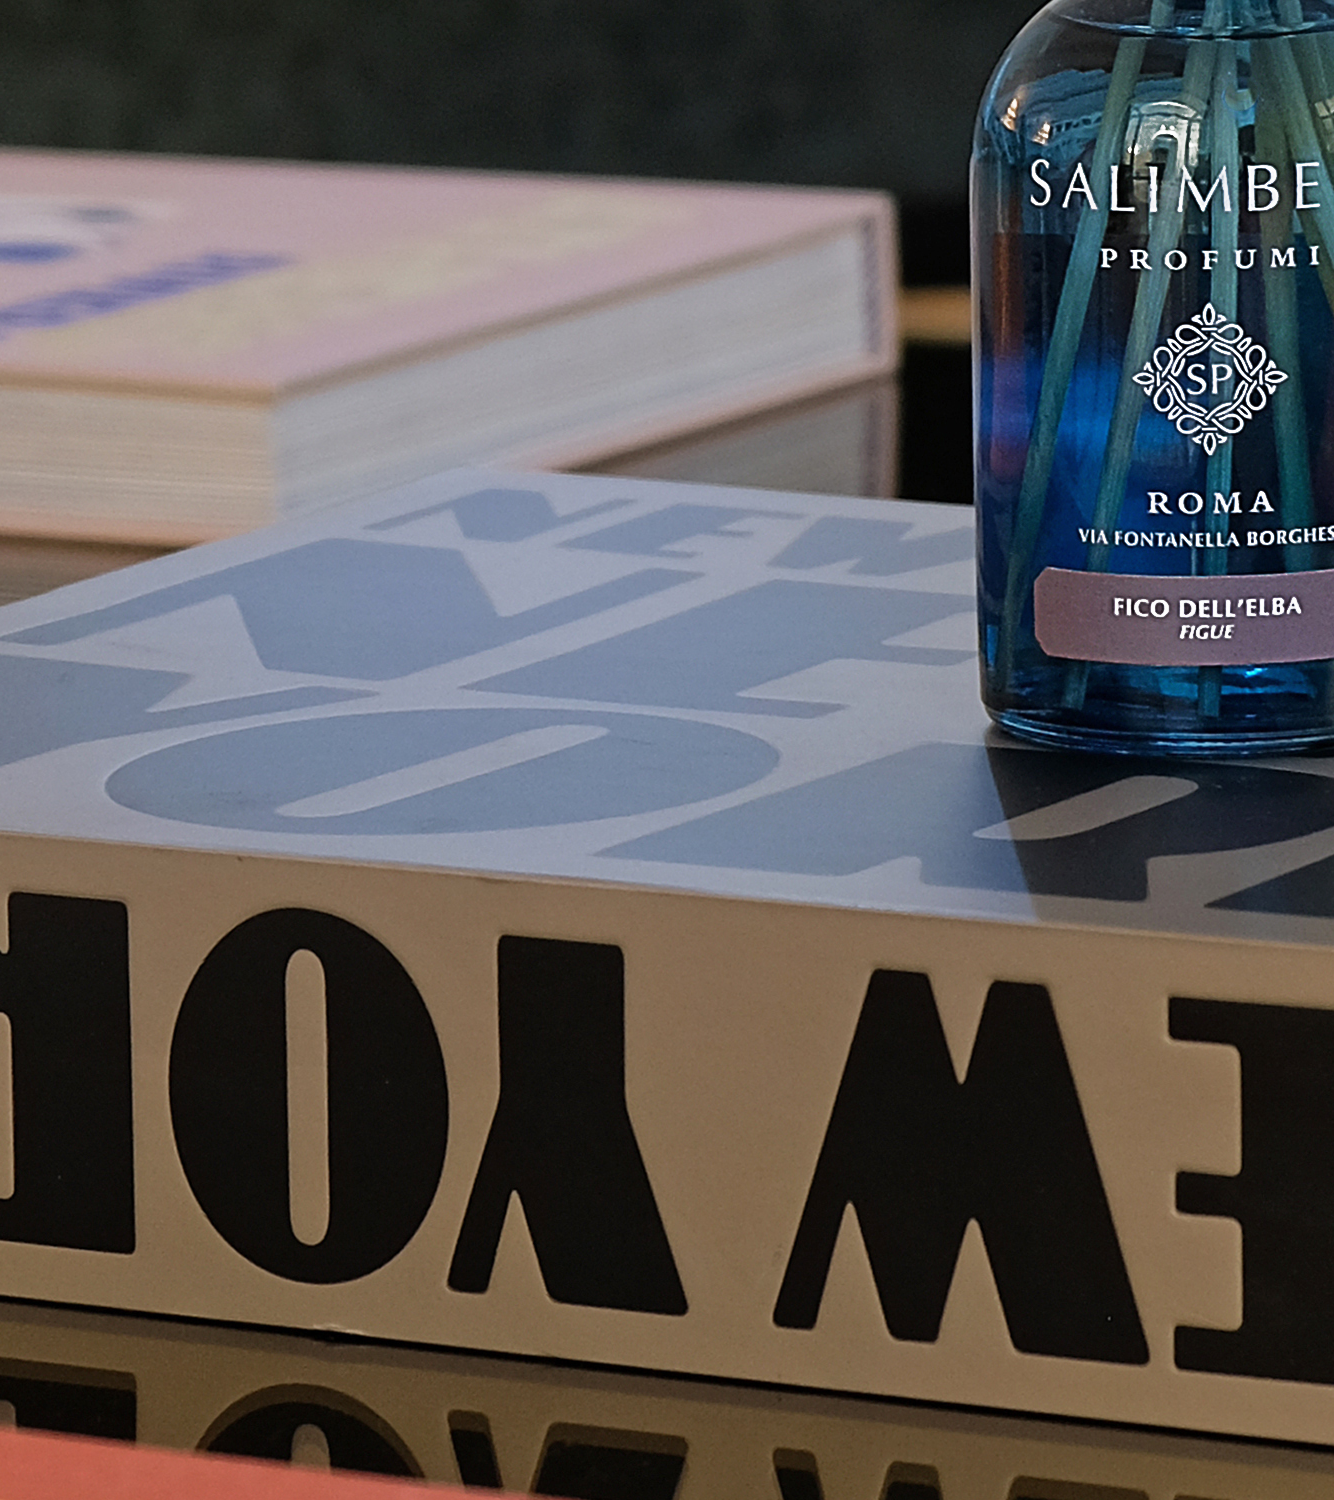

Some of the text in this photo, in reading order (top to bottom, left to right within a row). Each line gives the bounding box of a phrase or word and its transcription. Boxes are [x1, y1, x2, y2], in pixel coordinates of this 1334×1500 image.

[1100, 243, 1321, 272] PROFUMI
[1183, 359, 1236, 397] SP
[1146, 489, 1276, 516] ROMA
[1077, 527, 1109, 546] VIA
[1114, 530, 1240, 549] FONTANELLA
[1112, 595, 1303, 619] FICO DELL'ELBA
[1178, 623, 1235, 641] FIGUE
